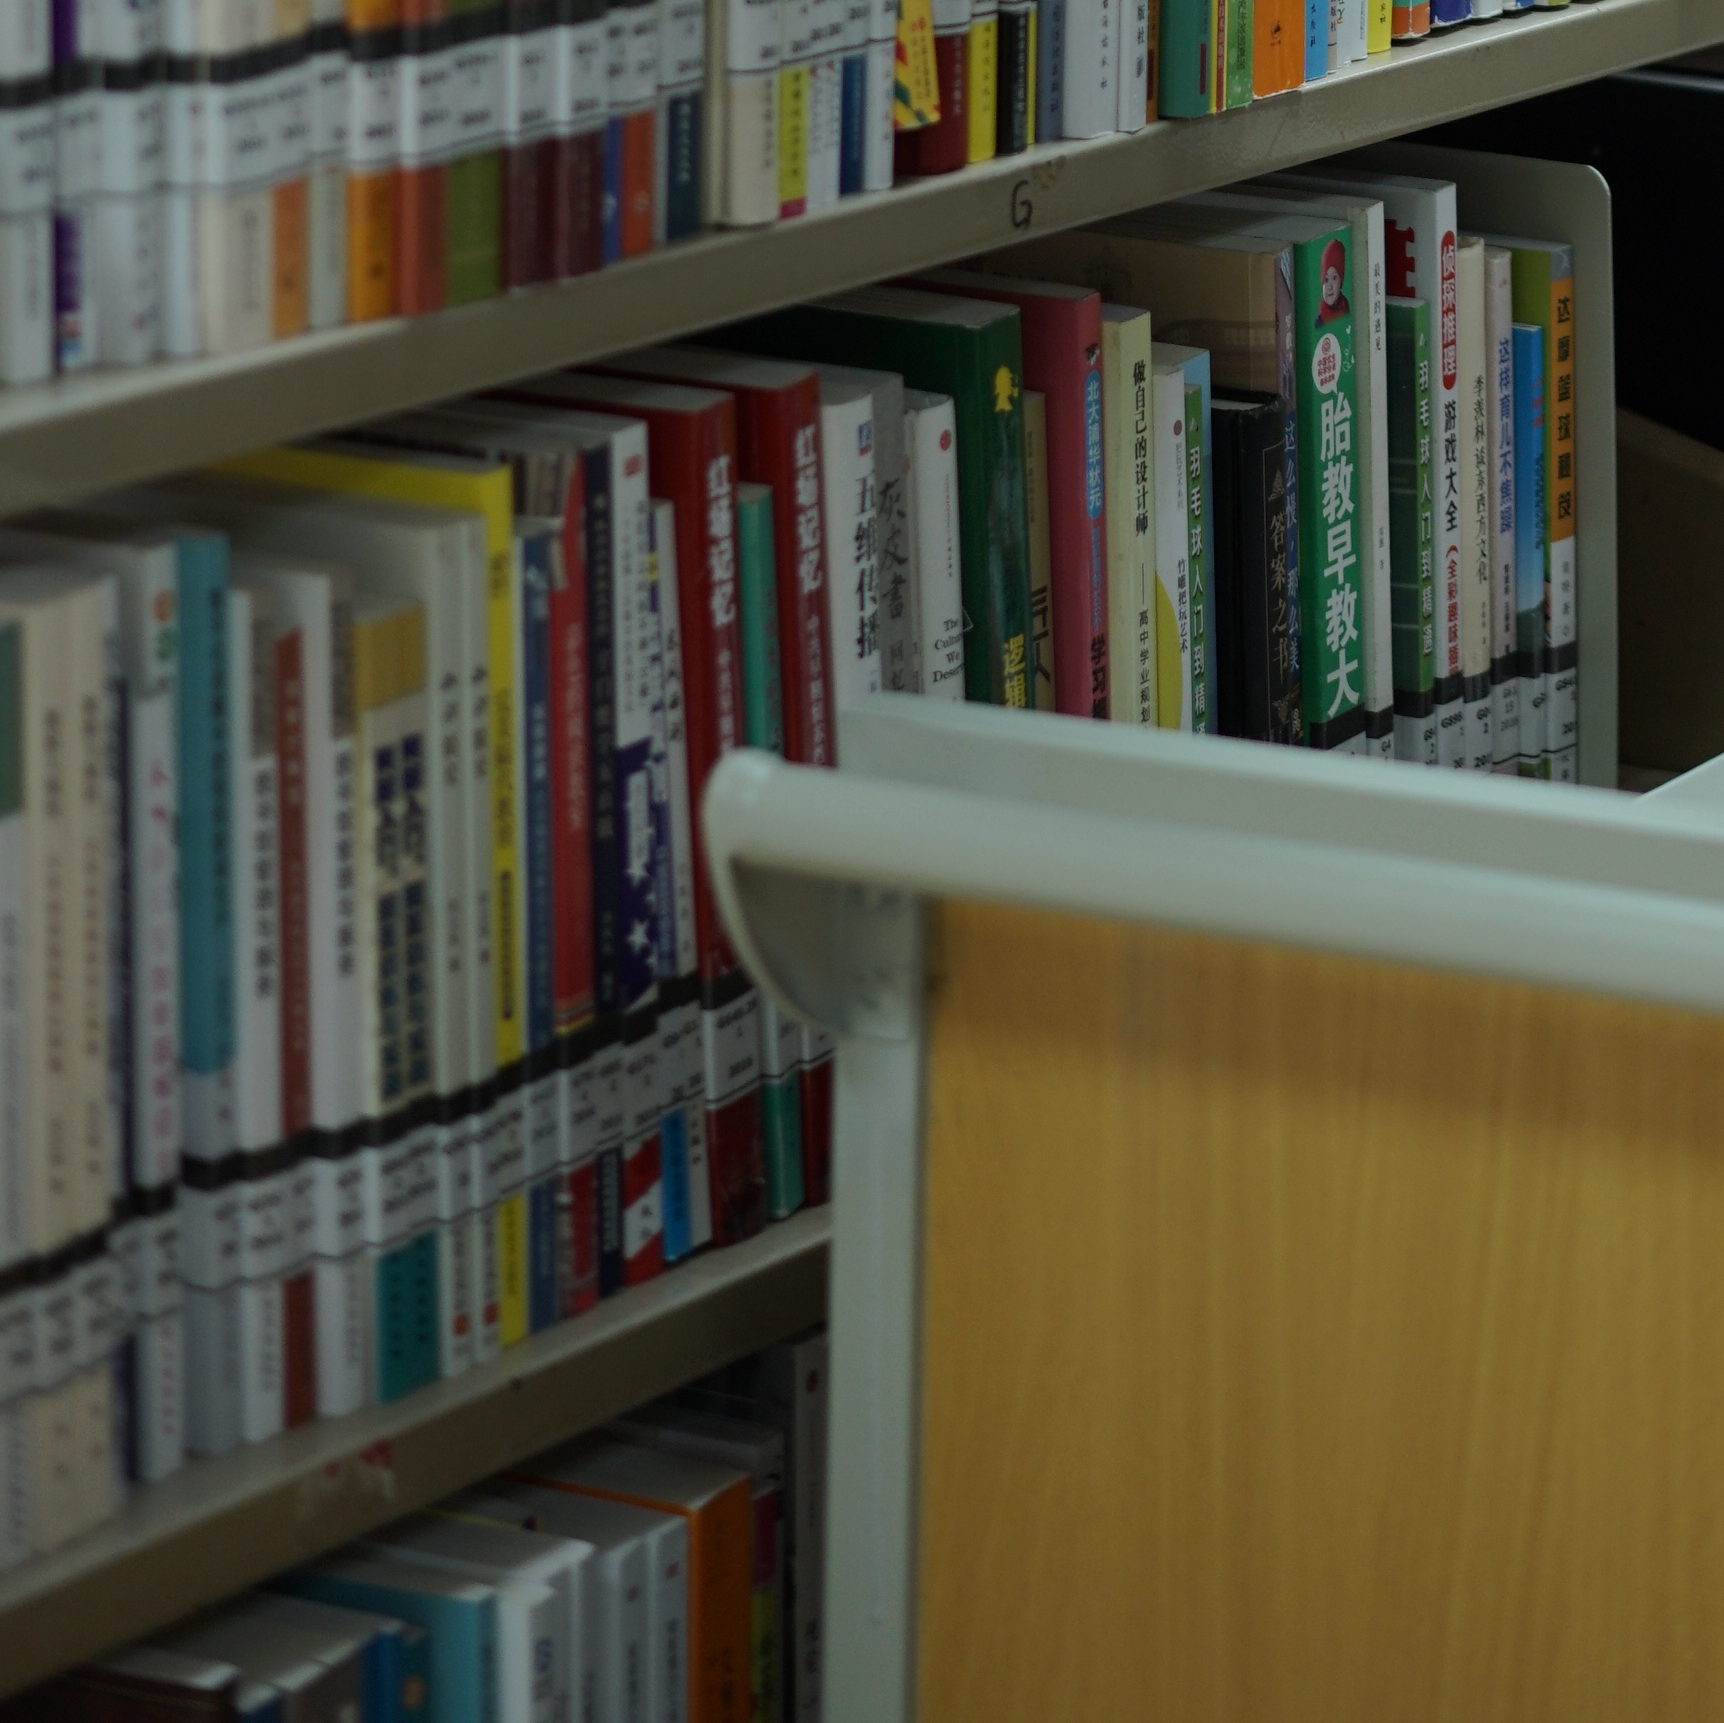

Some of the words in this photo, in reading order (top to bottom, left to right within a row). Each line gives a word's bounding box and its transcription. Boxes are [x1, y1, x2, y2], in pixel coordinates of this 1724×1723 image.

[1442, 243, 1456, 377] 侦探推理
[1086, 378, 1103, 511] 北大清华状元
[1133, 360, 1150, 537] 做自己的设计师
[1418, 359, 1433, 656] 羽毛球入门到精通
[1444, 400, 1458, 533] 游戏大全
[855, 473, 880, 660] 五维传播
[1177, 557, 1189, 655] 竹雕把玩艺术
[1270, 512, 1288, 687] 答案之书
[1320, 391, 1360, 720] 胎教早教大
[934, 632, 963, 650] Cultur
[946, 650, 960, 663] We
[1139, 608, 1152, 724] 高中学业规划
